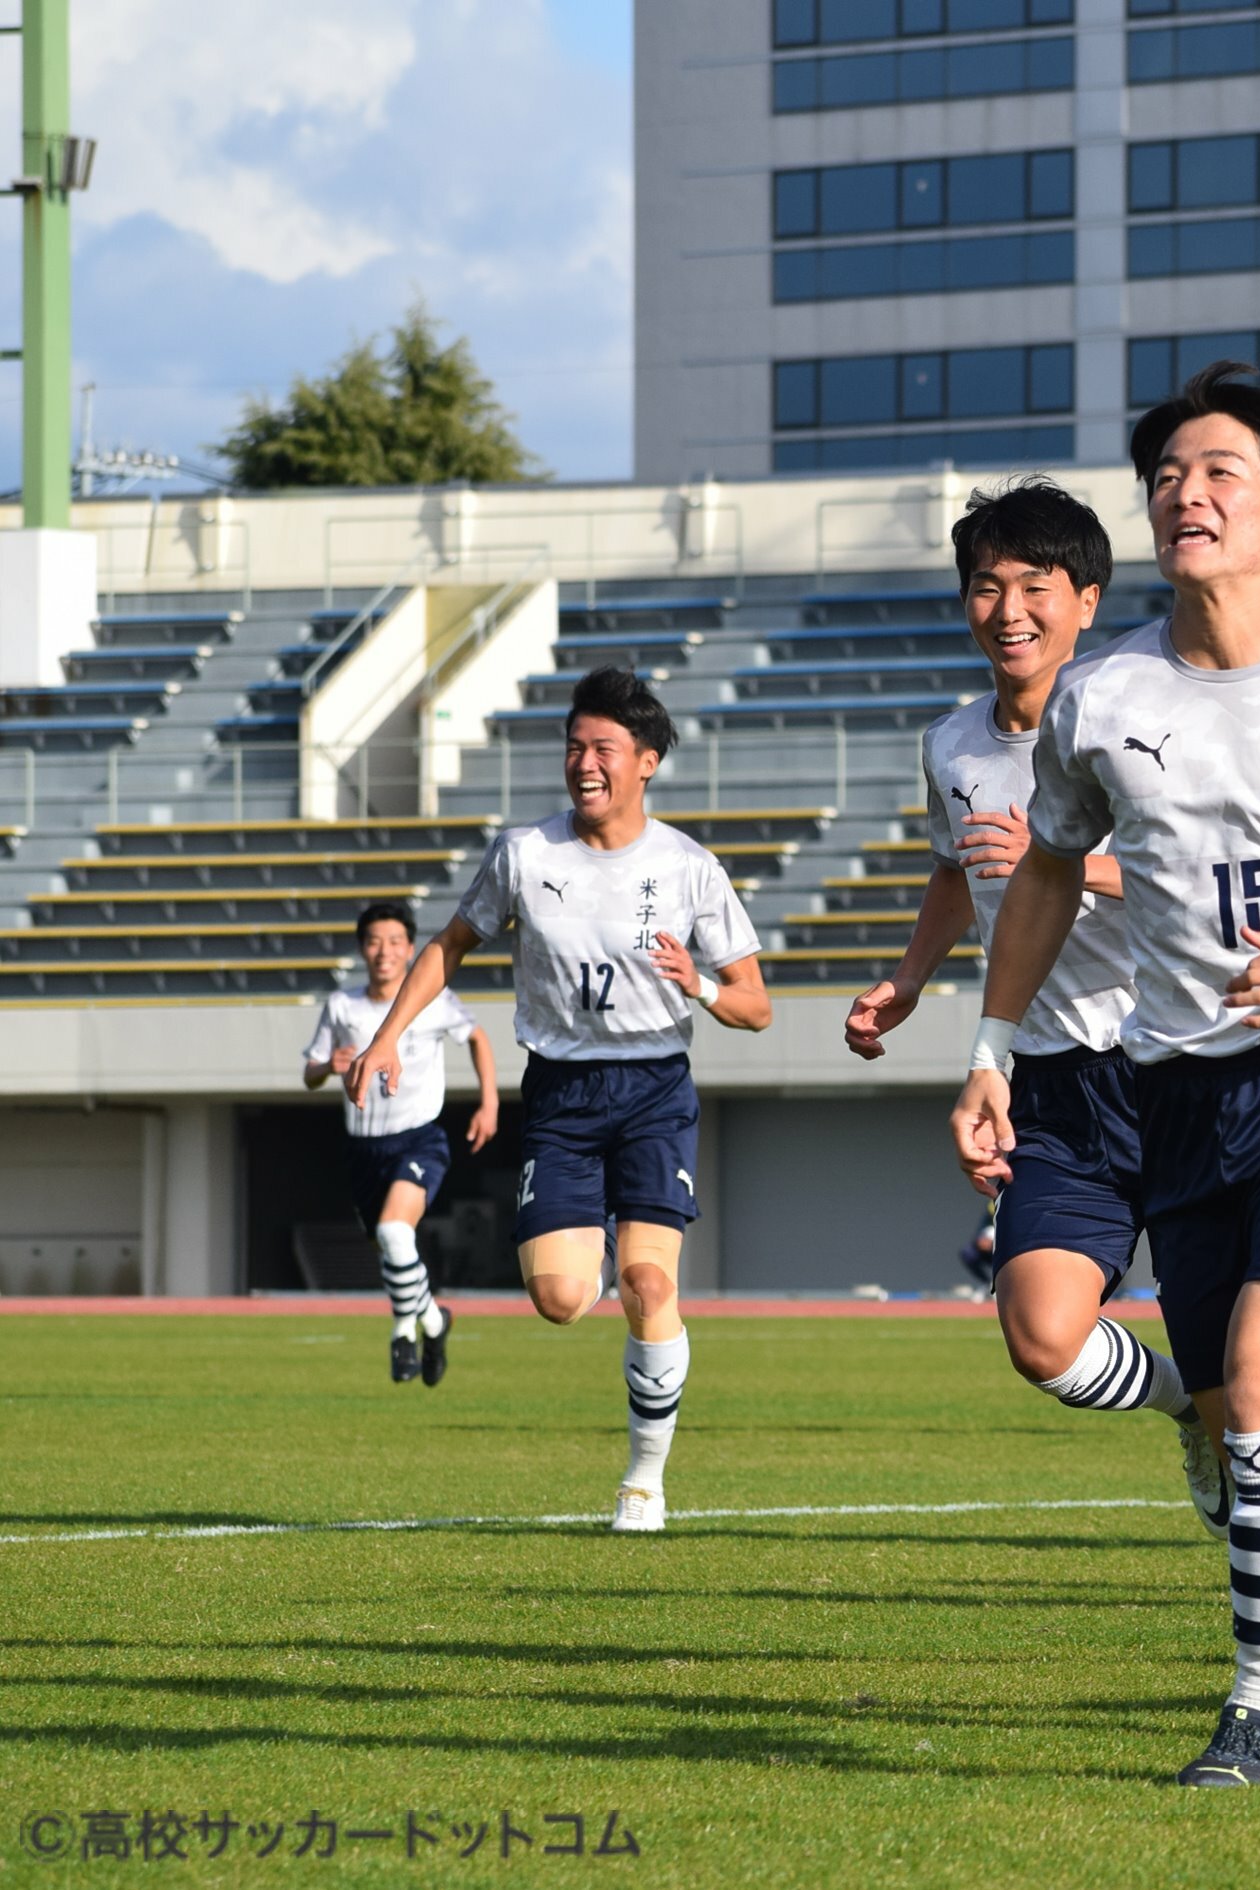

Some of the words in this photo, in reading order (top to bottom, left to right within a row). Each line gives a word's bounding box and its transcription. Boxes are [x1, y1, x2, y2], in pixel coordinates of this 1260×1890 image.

[633, 877, 658, 950] 米子北
[579, 962, 615, 1011] 12
[517, 1158, 536, 1212] 2
